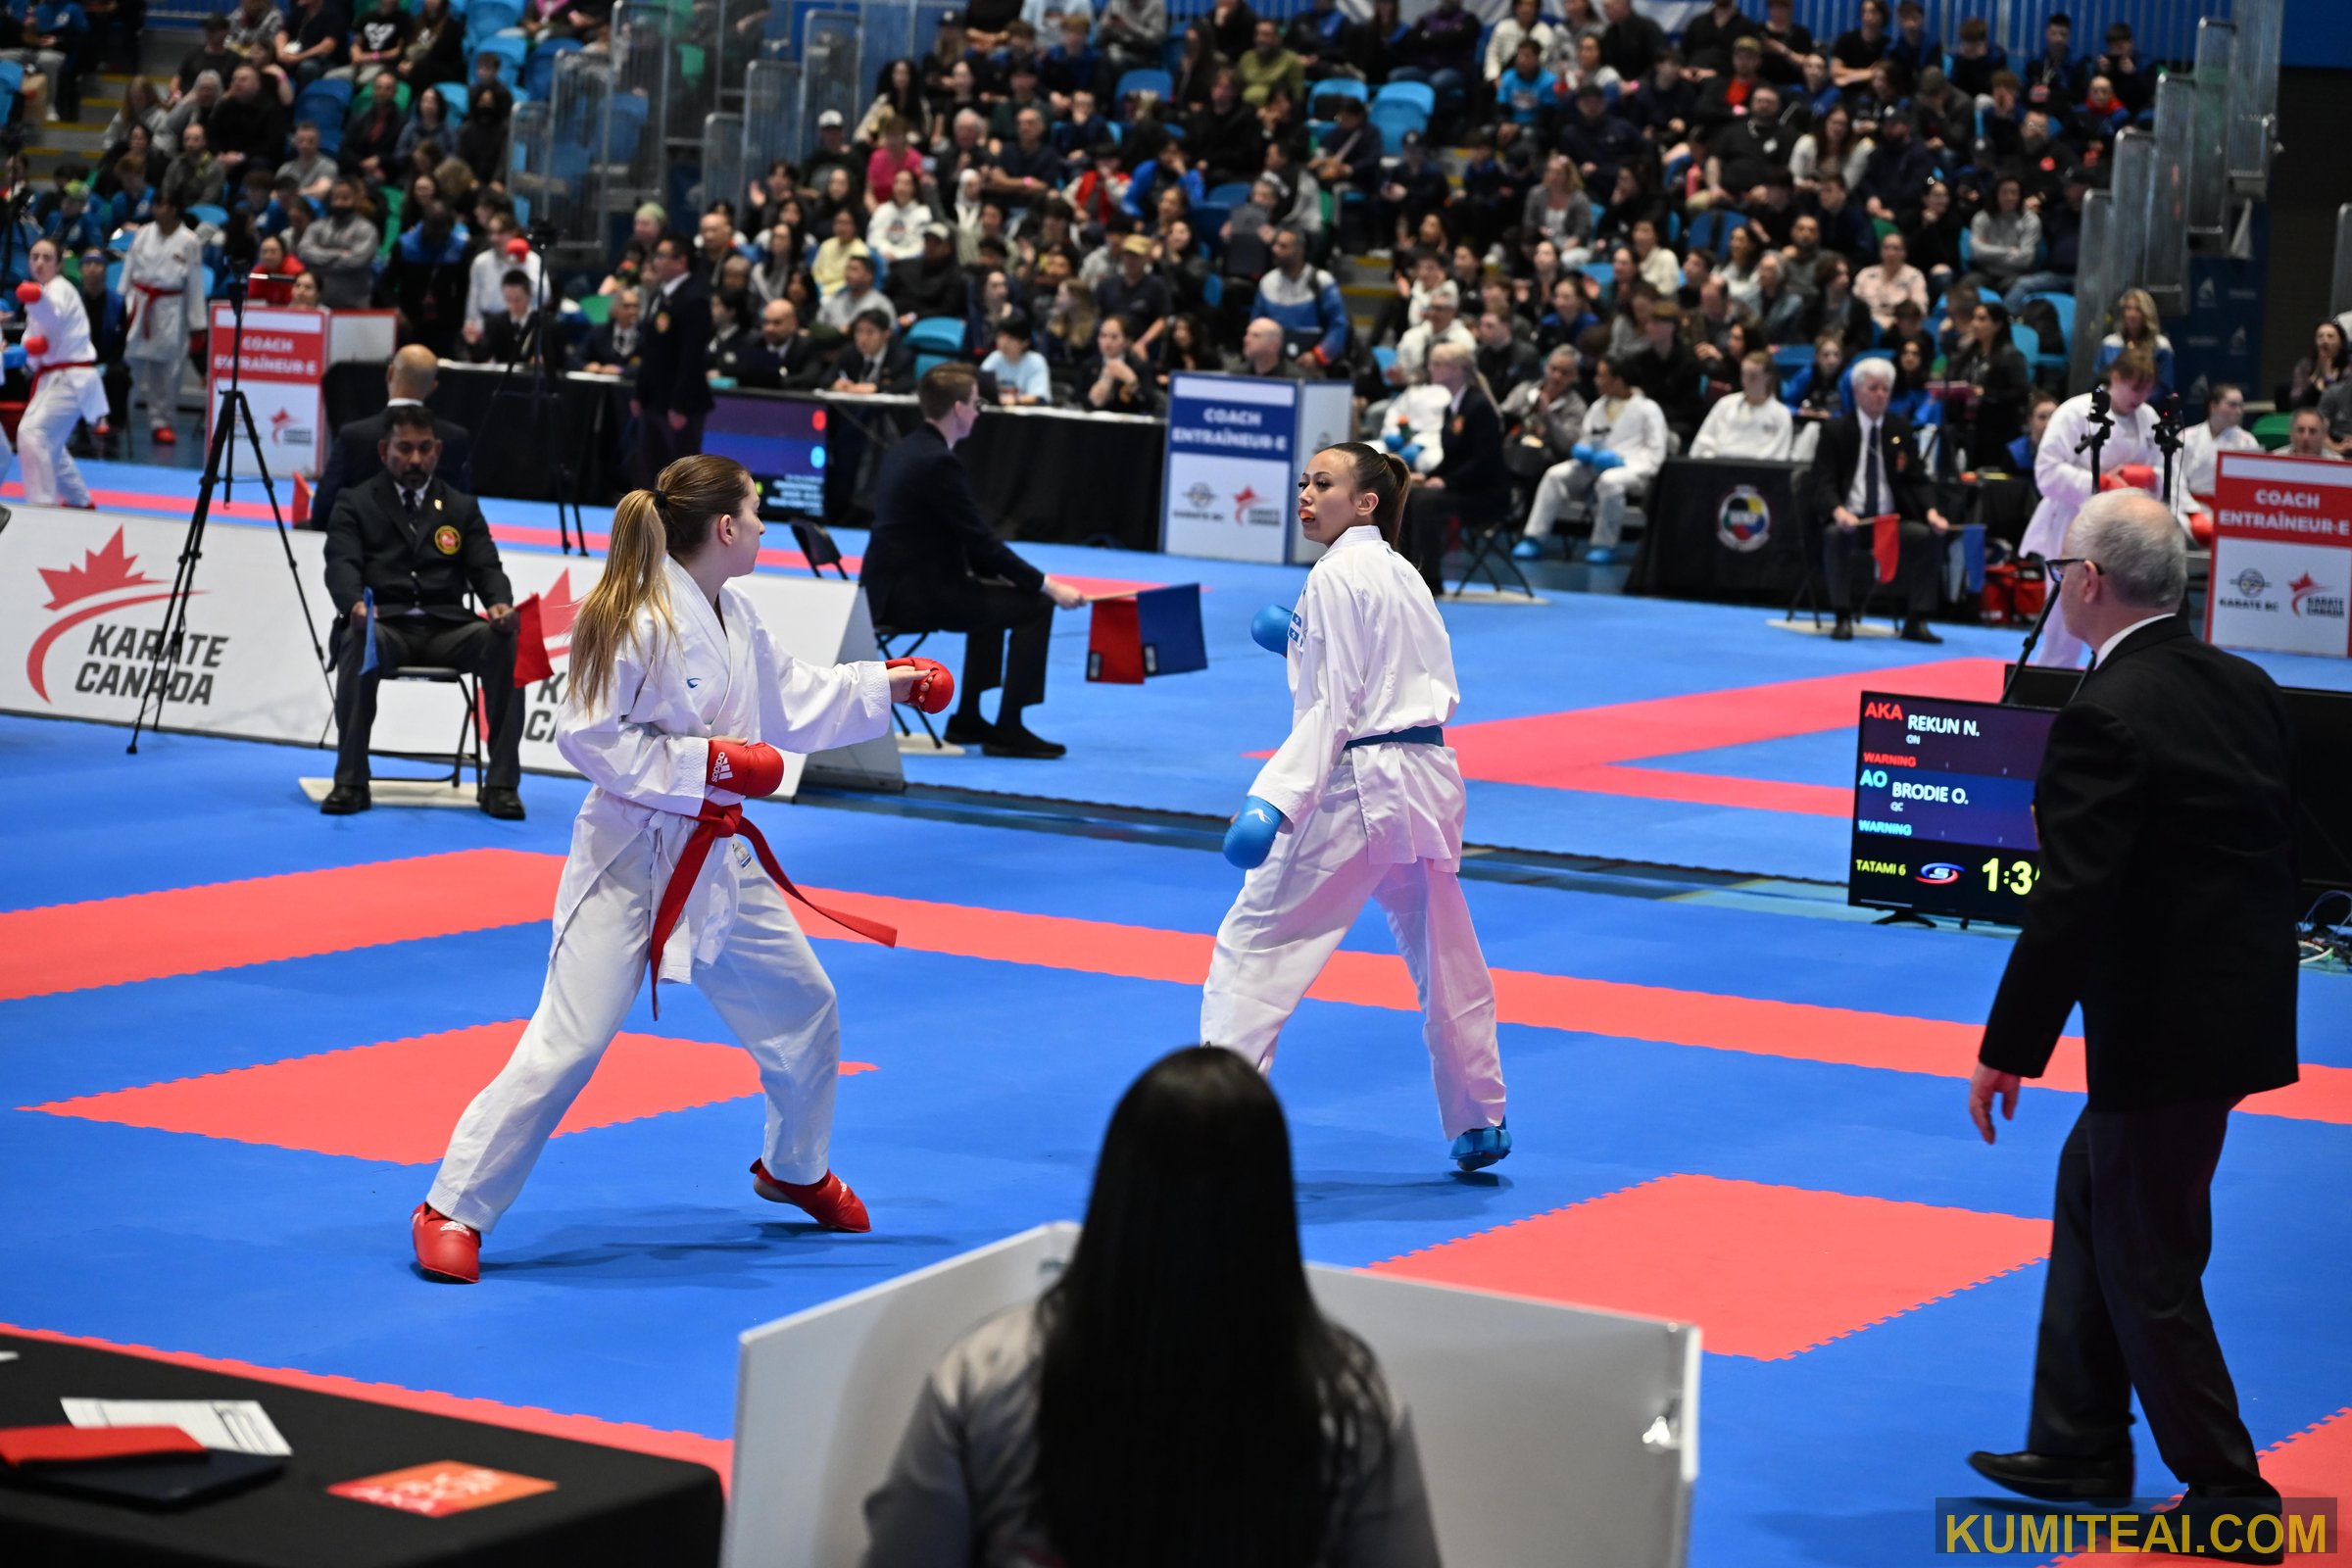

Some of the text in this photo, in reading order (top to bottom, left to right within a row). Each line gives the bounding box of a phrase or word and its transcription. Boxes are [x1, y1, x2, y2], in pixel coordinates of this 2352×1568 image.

[242, 336, 294, 353] COACH
[1203, 408, 1262, 425] COACH
[2255, 489, 2321, 508] COACH
[74, 661, 214, 706] CANADA
[1864, 701, 1981, 737] AKA REKUN N.
[1906, 734, 1921, 745] ON
[1863, 752, 1917, 768] WARNING
[1859, 768, 1969, 805] AO BRODIE O.
[1858, 819, 1912, 837] WARNING
[1855, 858, 1896, 875] TATAMI
[1898, 864, 1906, 877] 6
[1982, 858, 2040, 896] 1:3
